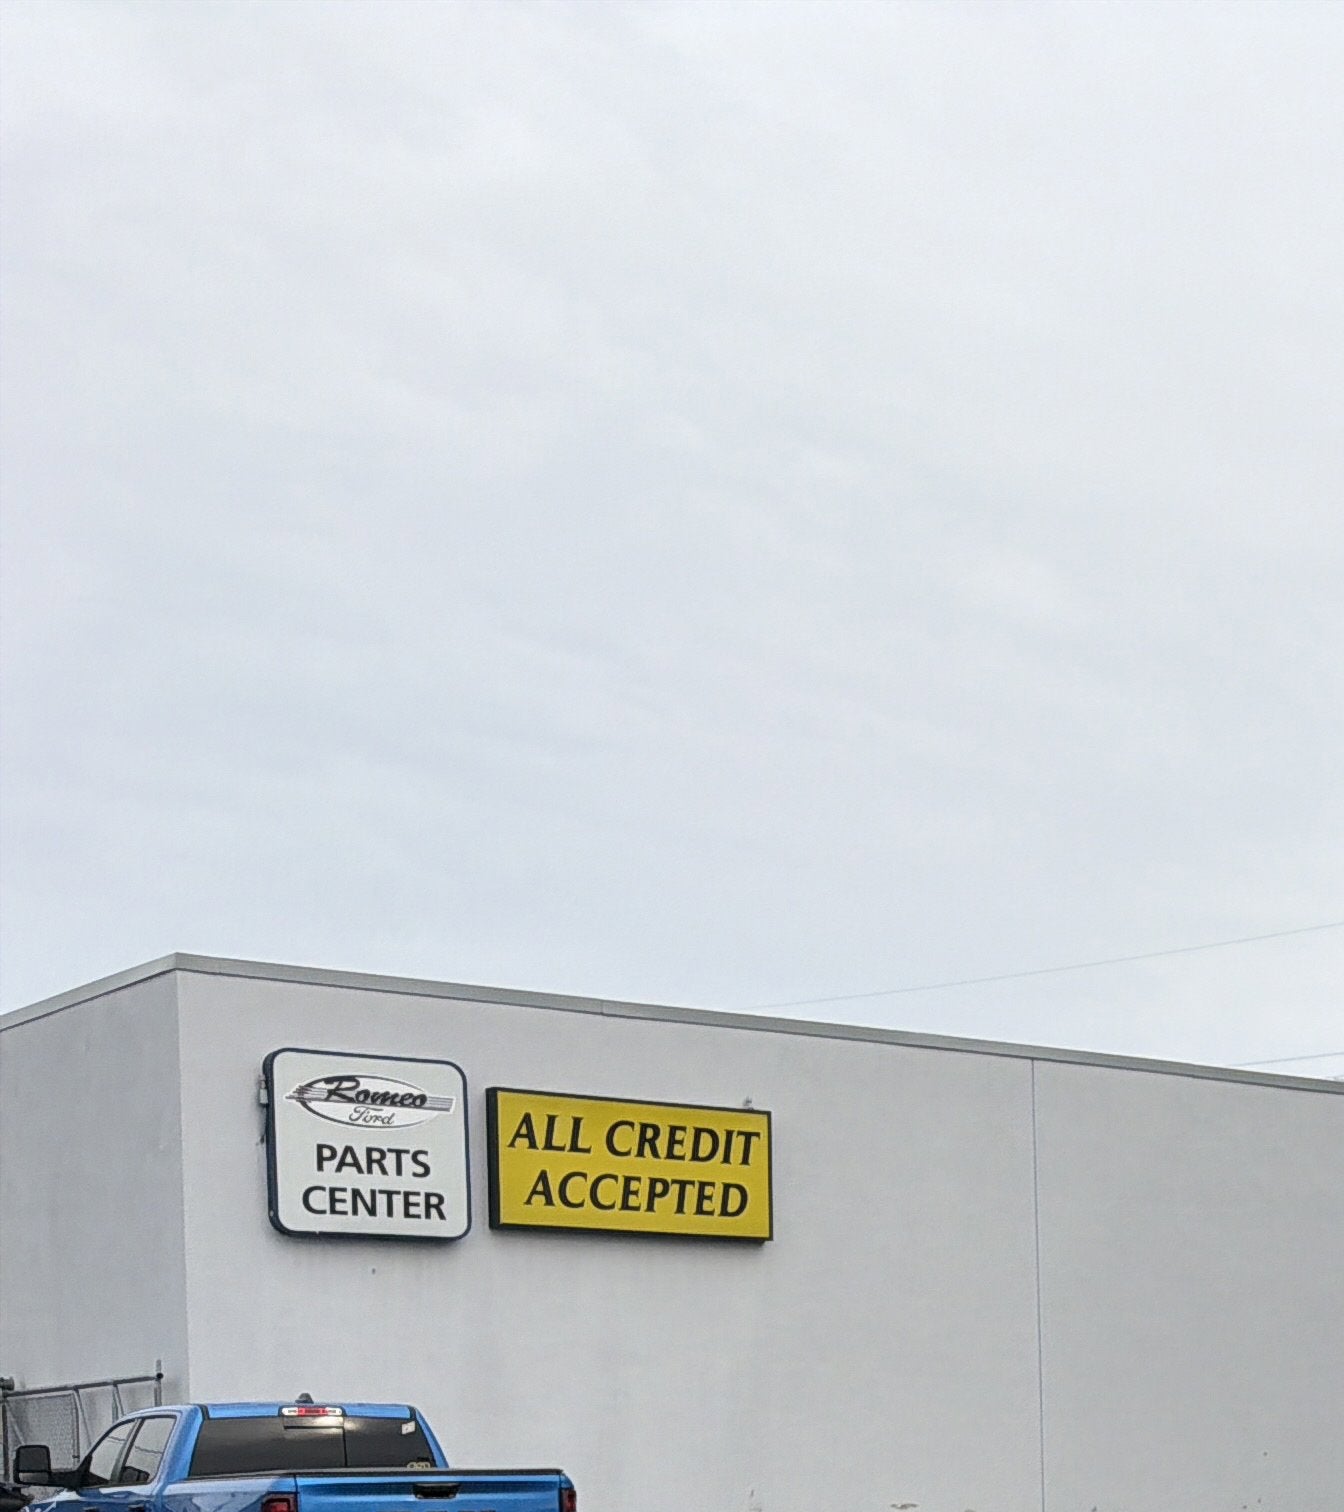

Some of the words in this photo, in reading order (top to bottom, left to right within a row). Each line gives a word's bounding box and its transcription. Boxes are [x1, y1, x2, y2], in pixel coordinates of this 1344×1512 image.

[323, 1077, 428, 1107] Romeo
[349, 1105, 395, 1125] Ford
[507, 1112, 592, 1154] ALL
[605, 1120, 761, 1167] CREDIT
[315, 1144, 430, 1178] PARTS
[302, 1186, 446, 1221] CENTER
[524, 1169, 750, 1218] ACCEPTED
